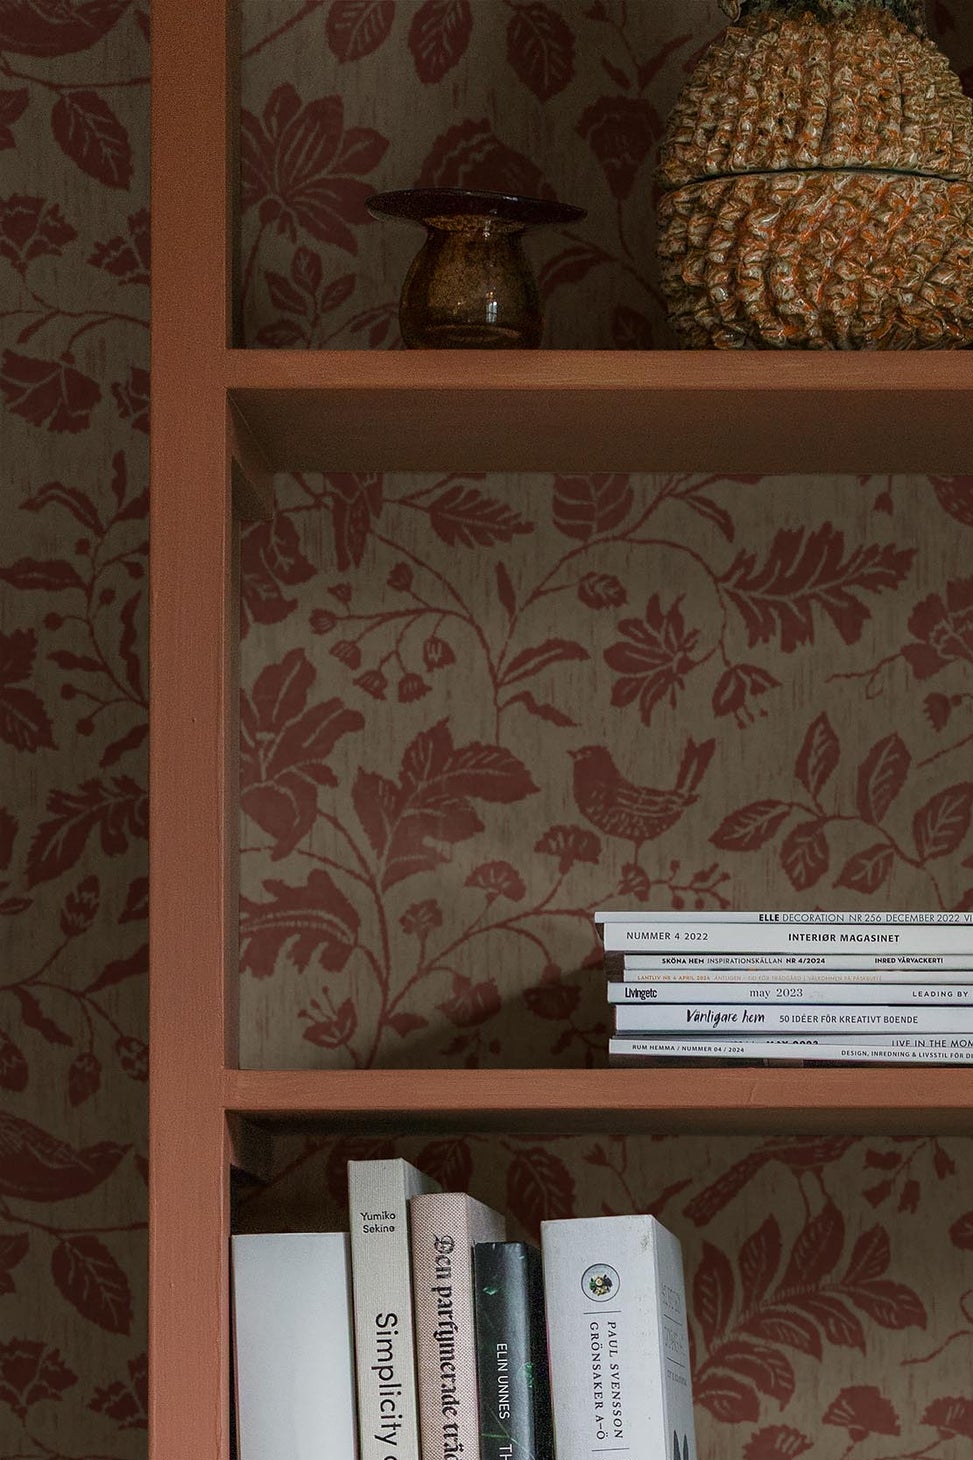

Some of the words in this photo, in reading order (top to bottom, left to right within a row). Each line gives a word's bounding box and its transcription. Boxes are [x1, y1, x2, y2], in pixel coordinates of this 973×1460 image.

[759, 914, 779, 922] ELLE
[783, 914, 845, 922] DECORATION
[850, 914, 862, 922] NR
[864, 914, 881, 922] 256
[886, 914, 934, 922] DECEMBER
[937, 914, 960, 922] 2022
[626, 932, 671, 940] NUMMER
[788, 933, 836, 942] INTERIØR
[840, 934, 900, 942] MAGASINET
[625, 987, 658, 1000] Livingetc
[749, 990, 771, 999] may
[776, 988, 803, 998] 2023
[686, 1009, 738, 1028] Vänligare
[742, 1009, 765, 1023] hem
[779, 1015, 789, 1023] 50
[791, 1013, 818, 1023] IDÉER
[821, 1013, 837, 1023] FÖR
[839, 1015, 881, 1024] KREATIVT
[883, 1016, 918, 1024] BOENDE
[360, 1211, 396, 1221] Yumiko
[363, 1224, 395, 1234] Sekine
[434, 1235, 455, 1280] Den
[431, 1286, 460, 1416] parfymerade
[607, 1321, 618, 1358] PAUL
[496, 1343, 508, 1372] ELIN
[590, 1321, 604, 1410] GRÖNSAKER
[371, 1312, 403, 1446] Simplicity
[498, 1376, 511, 1420] UNNES
[609, 1363, 624, 1439] SVENSSON
